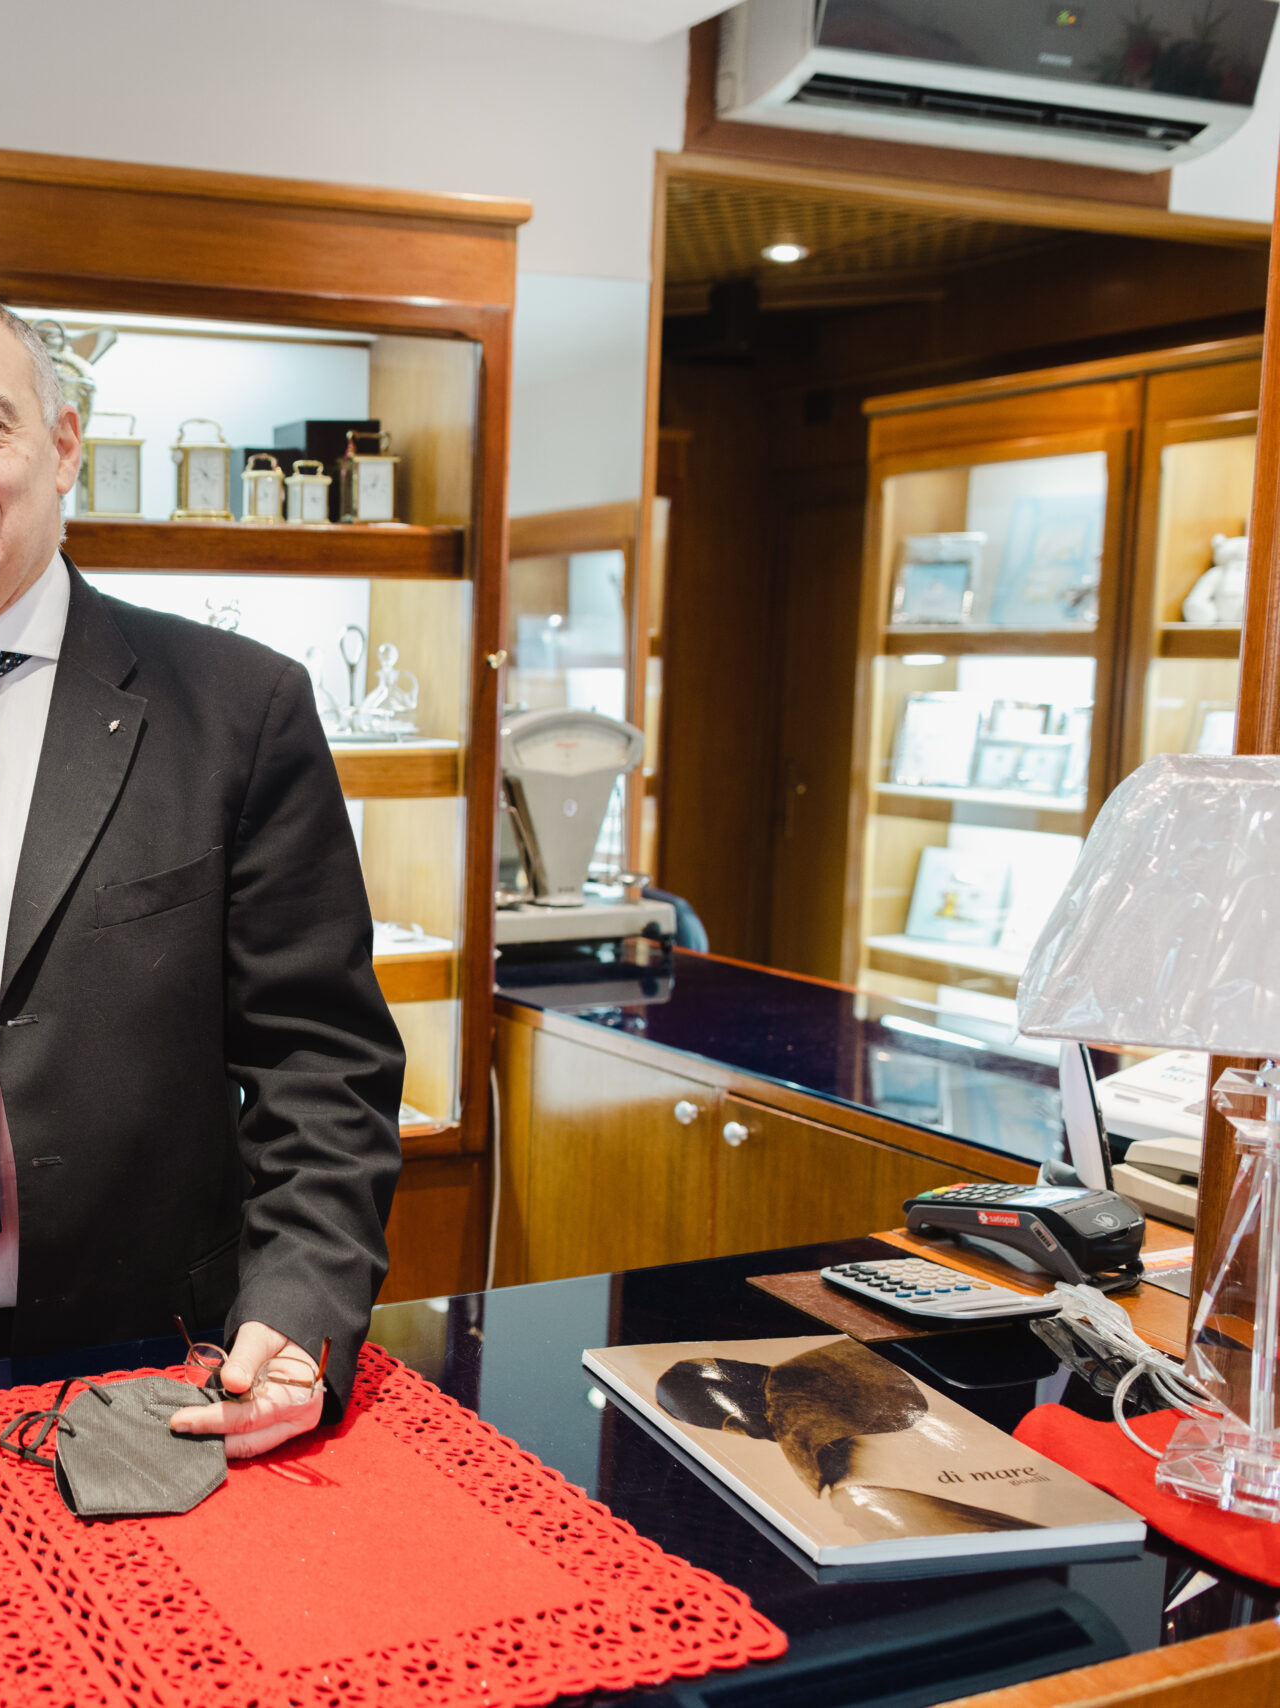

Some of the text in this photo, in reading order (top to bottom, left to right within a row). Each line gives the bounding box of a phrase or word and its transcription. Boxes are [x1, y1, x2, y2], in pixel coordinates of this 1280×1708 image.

[989, 1215, 1017, 1225] satispay
[937, 1466, 1038, 1485] di mare
